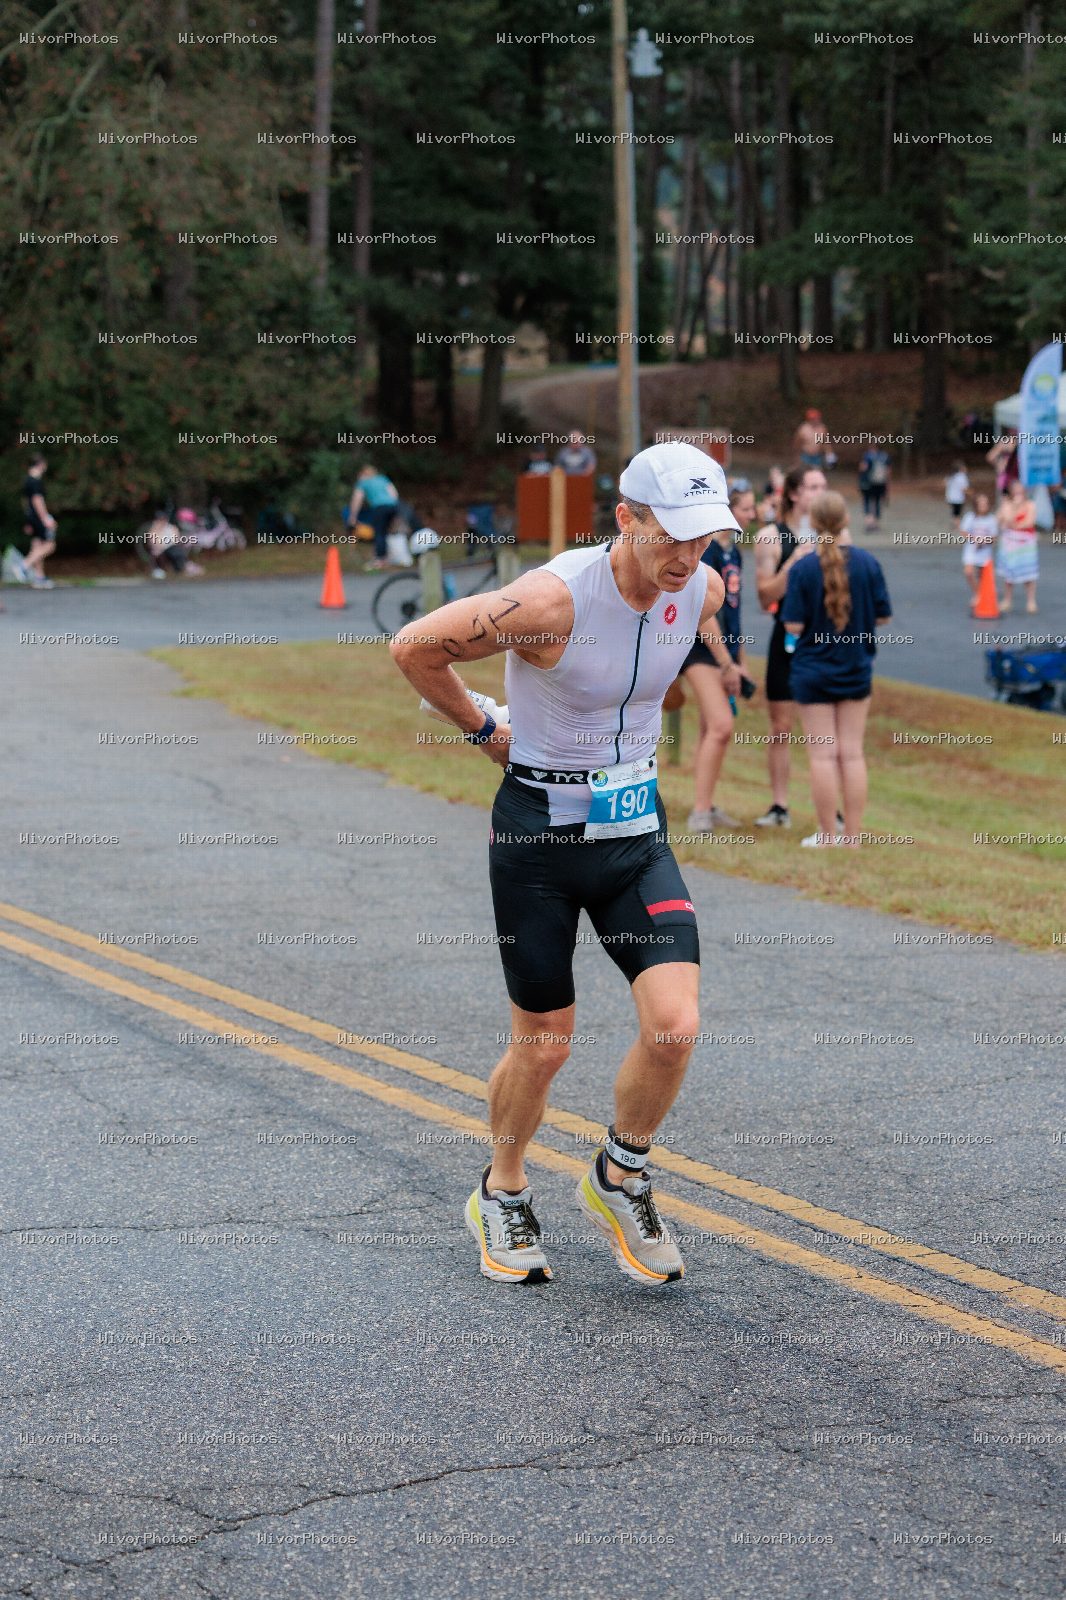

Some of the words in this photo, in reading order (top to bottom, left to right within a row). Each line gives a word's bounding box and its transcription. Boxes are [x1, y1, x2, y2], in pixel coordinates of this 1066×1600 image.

[552, 772, 586, 783] TYR
[607, 785, 649, 820] 190
[620, 1153, 636, 1165] 190
